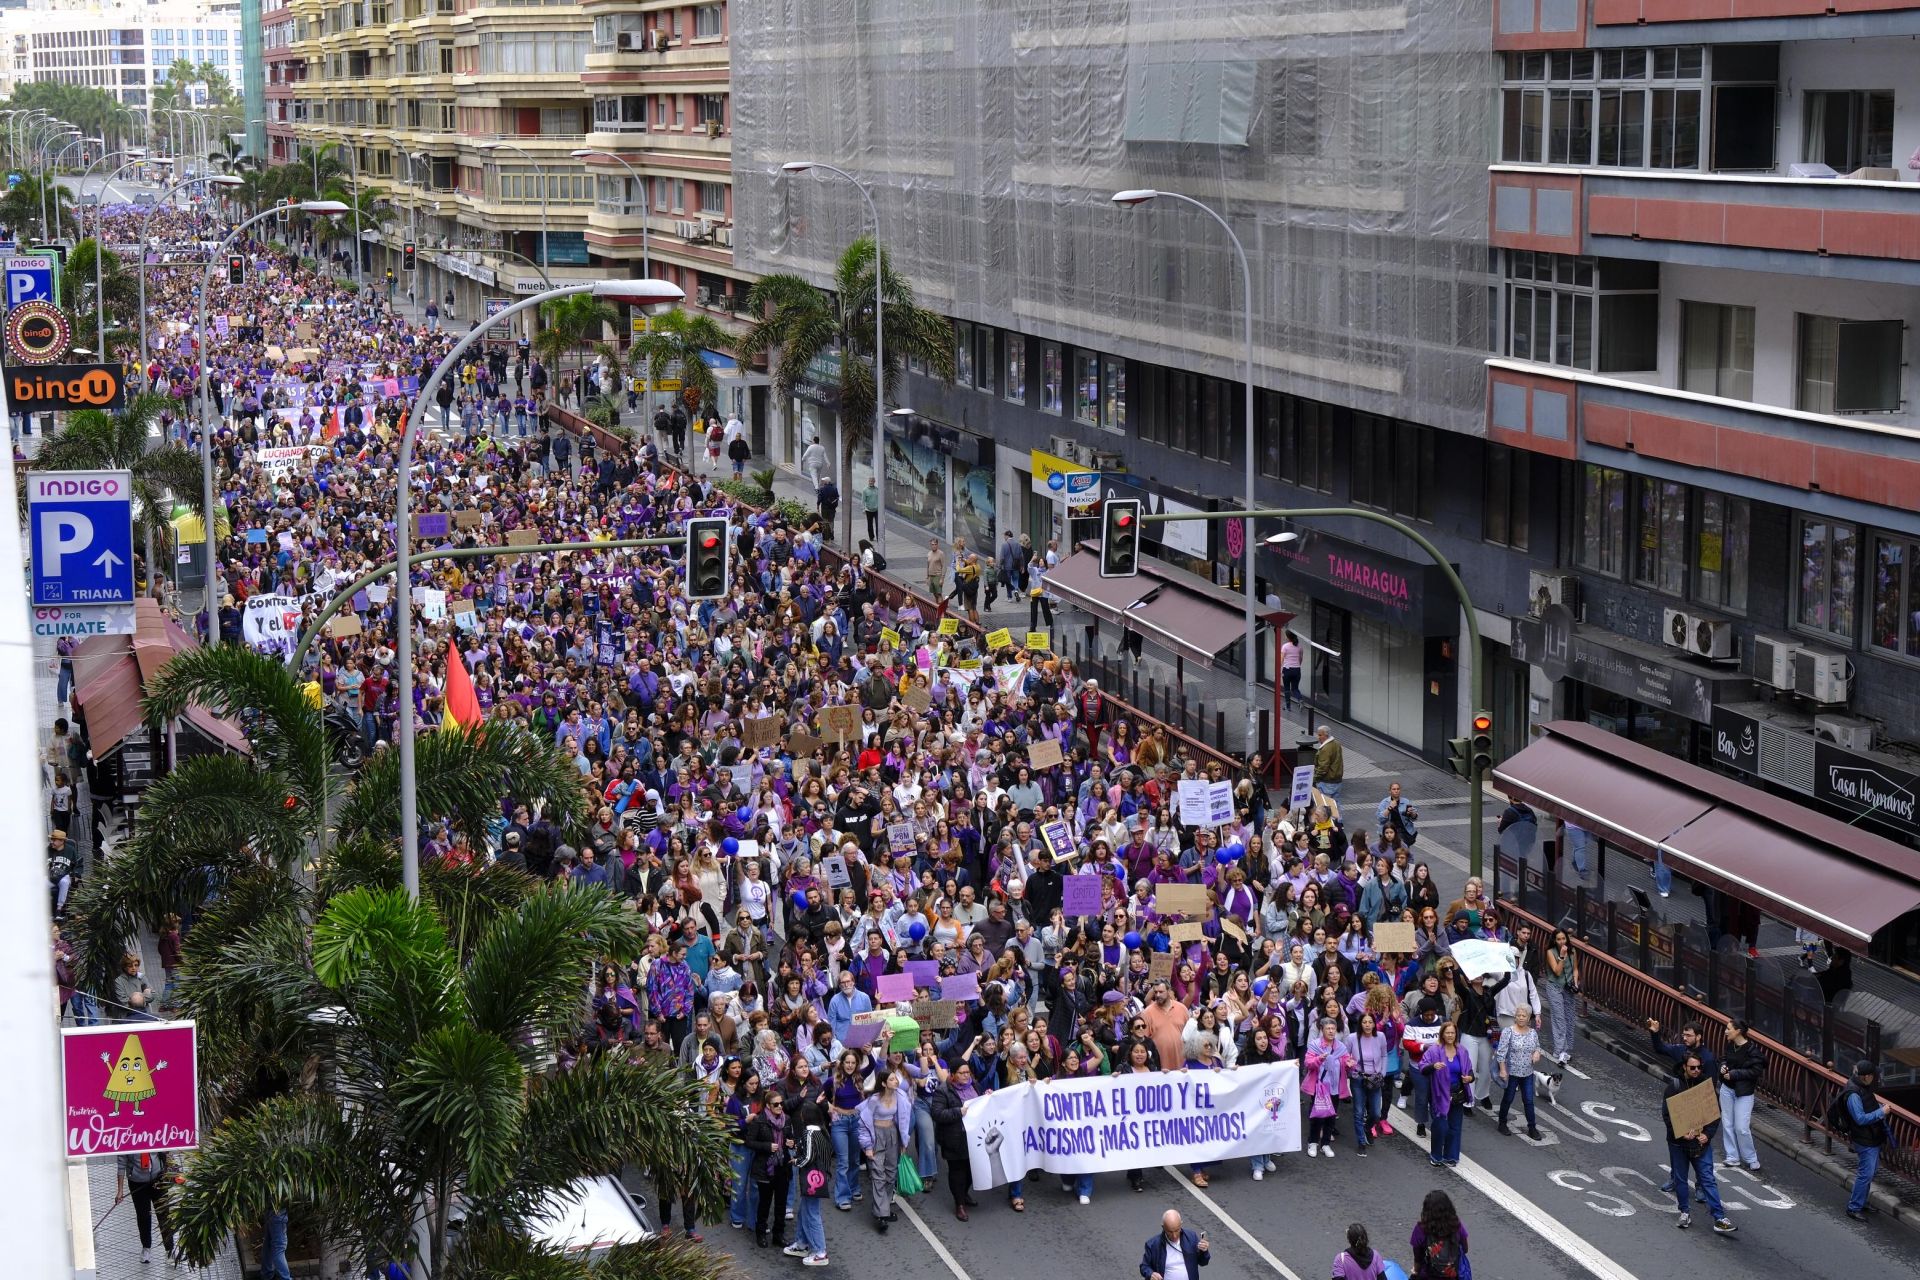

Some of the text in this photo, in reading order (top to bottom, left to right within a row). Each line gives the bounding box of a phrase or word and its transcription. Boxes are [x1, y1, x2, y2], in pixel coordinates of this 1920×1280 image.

[10, 259, 46, 268] INDIGO
[10, 273, 36, 304] P
[518, 282, 561, 290] muebes
[40, 480, 118, 496] INDIGO
[40, 511, 94, 577] P
[1328, 554, 1408, 600] TAMARAGUA
[72, 589, 122, 600] TRIANA
[36, 607, 61, 620] GO
[36, 622, 106, 636] CLIMATE
[1542, 624, 1568, 663] JLH
[1718, 730, 1738, 760] Bar
[1831, 769, 1915, 821] Casa Hermanos
[1043, 1082, 1214, 1121] CONTRA EL ODIO Y EL
[1264, 1088, 1284, 1096] RED
[69, 1115, 194, 1153] Watermelon
[1022, 1111, 1246, 1158] FASCISMO ¡MÁS FEMINISMOS!
